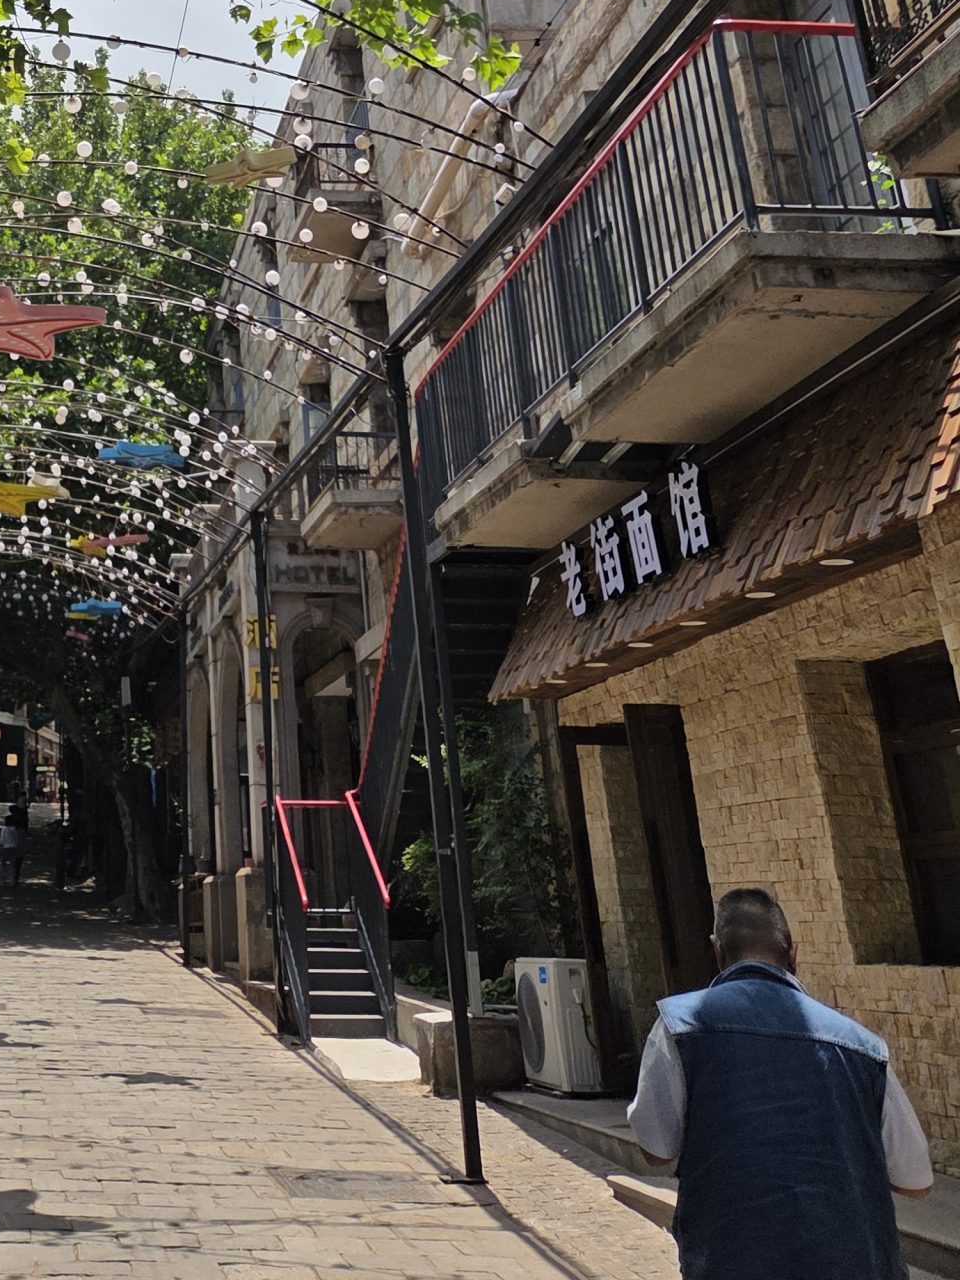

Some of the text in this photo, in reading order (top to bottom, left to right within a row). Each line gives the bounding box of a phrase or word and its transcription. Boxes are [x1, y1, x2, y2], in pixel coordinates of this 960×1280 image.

[274, 564, 356, 586] HOTEL
[558, 461, 710, 617] 老街面馆
